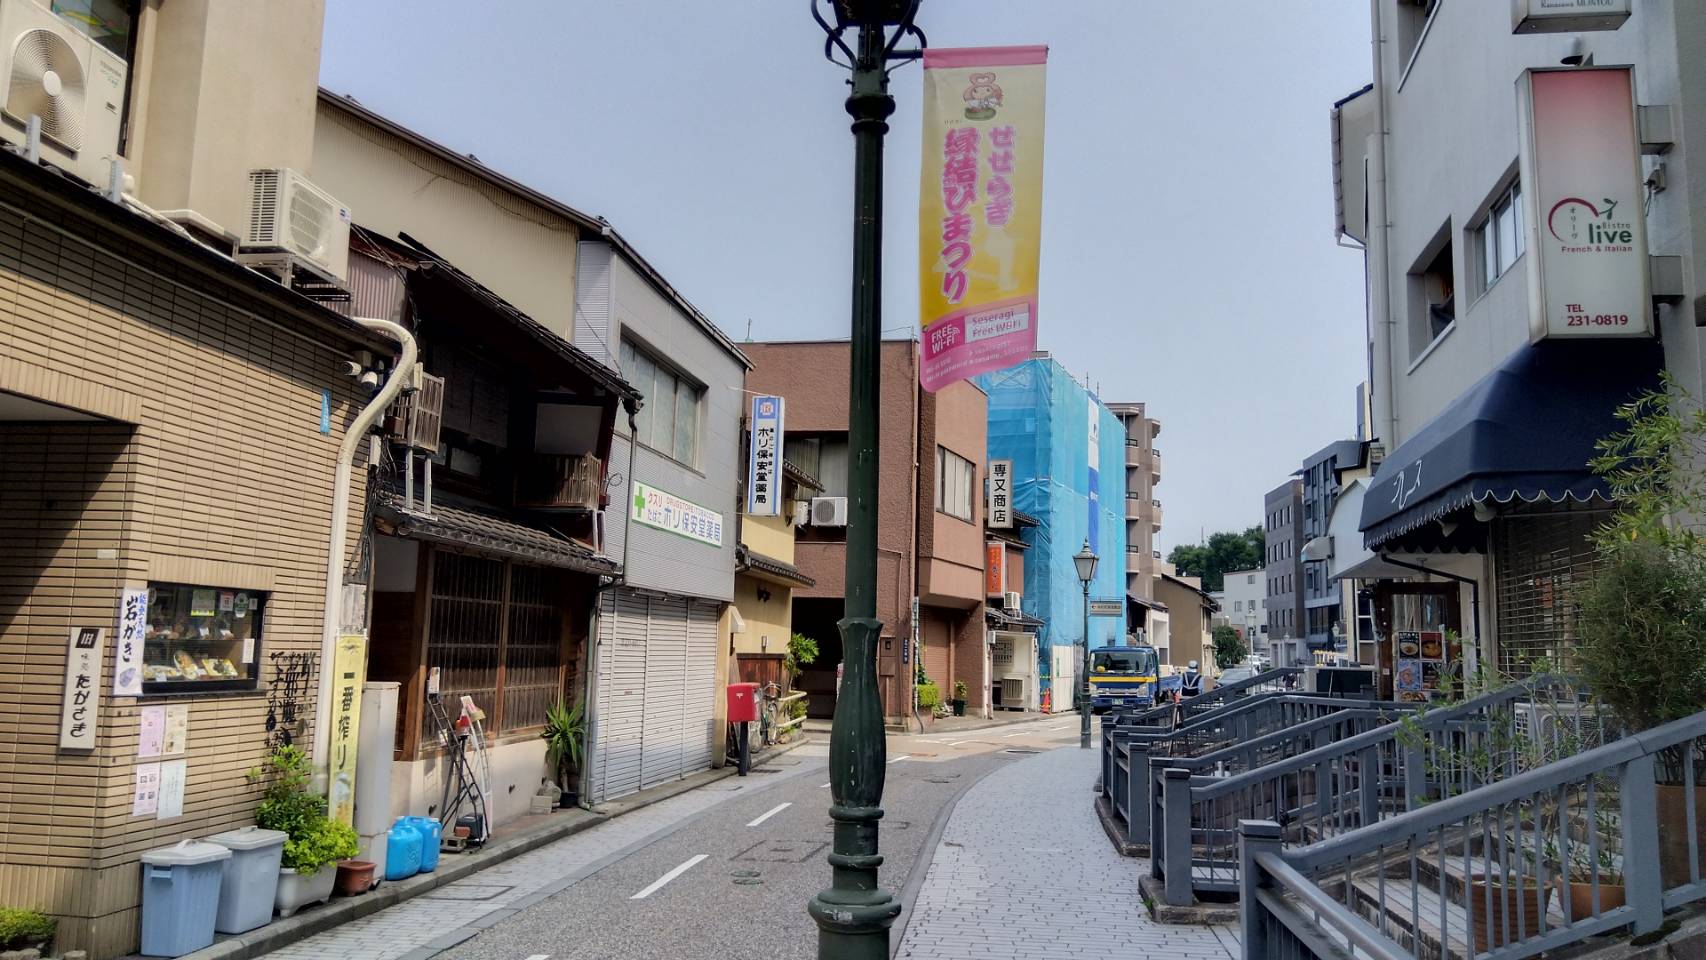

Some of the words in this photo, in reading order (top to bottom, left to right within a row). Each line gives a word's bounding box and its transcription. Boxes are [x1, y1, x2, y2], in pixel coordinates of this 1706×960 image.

[985, 126, 1014, 226] せせらぎ
[942, 126, 978, 304] 縁結びまつり
[972, 309, 1015, 326] Seseragi
[1566, 304, 1584, 313] TEL
[1567, 314, 1629, 327] 231-0819
[931, 324, 954, 343] FREE
[754, 427, 769, 504] ホリ保安堂薬局
[648, 491, 663, 507] クスリ
[648, 508, 662, 524] たばこ
[664, 505, 721, 542] ホリ保安堂薬局
[123, 594, 139, 662] 岩がき
[70, 674, 92, 738] たかさき
[337, 672, 355, 769] 一番搾り
